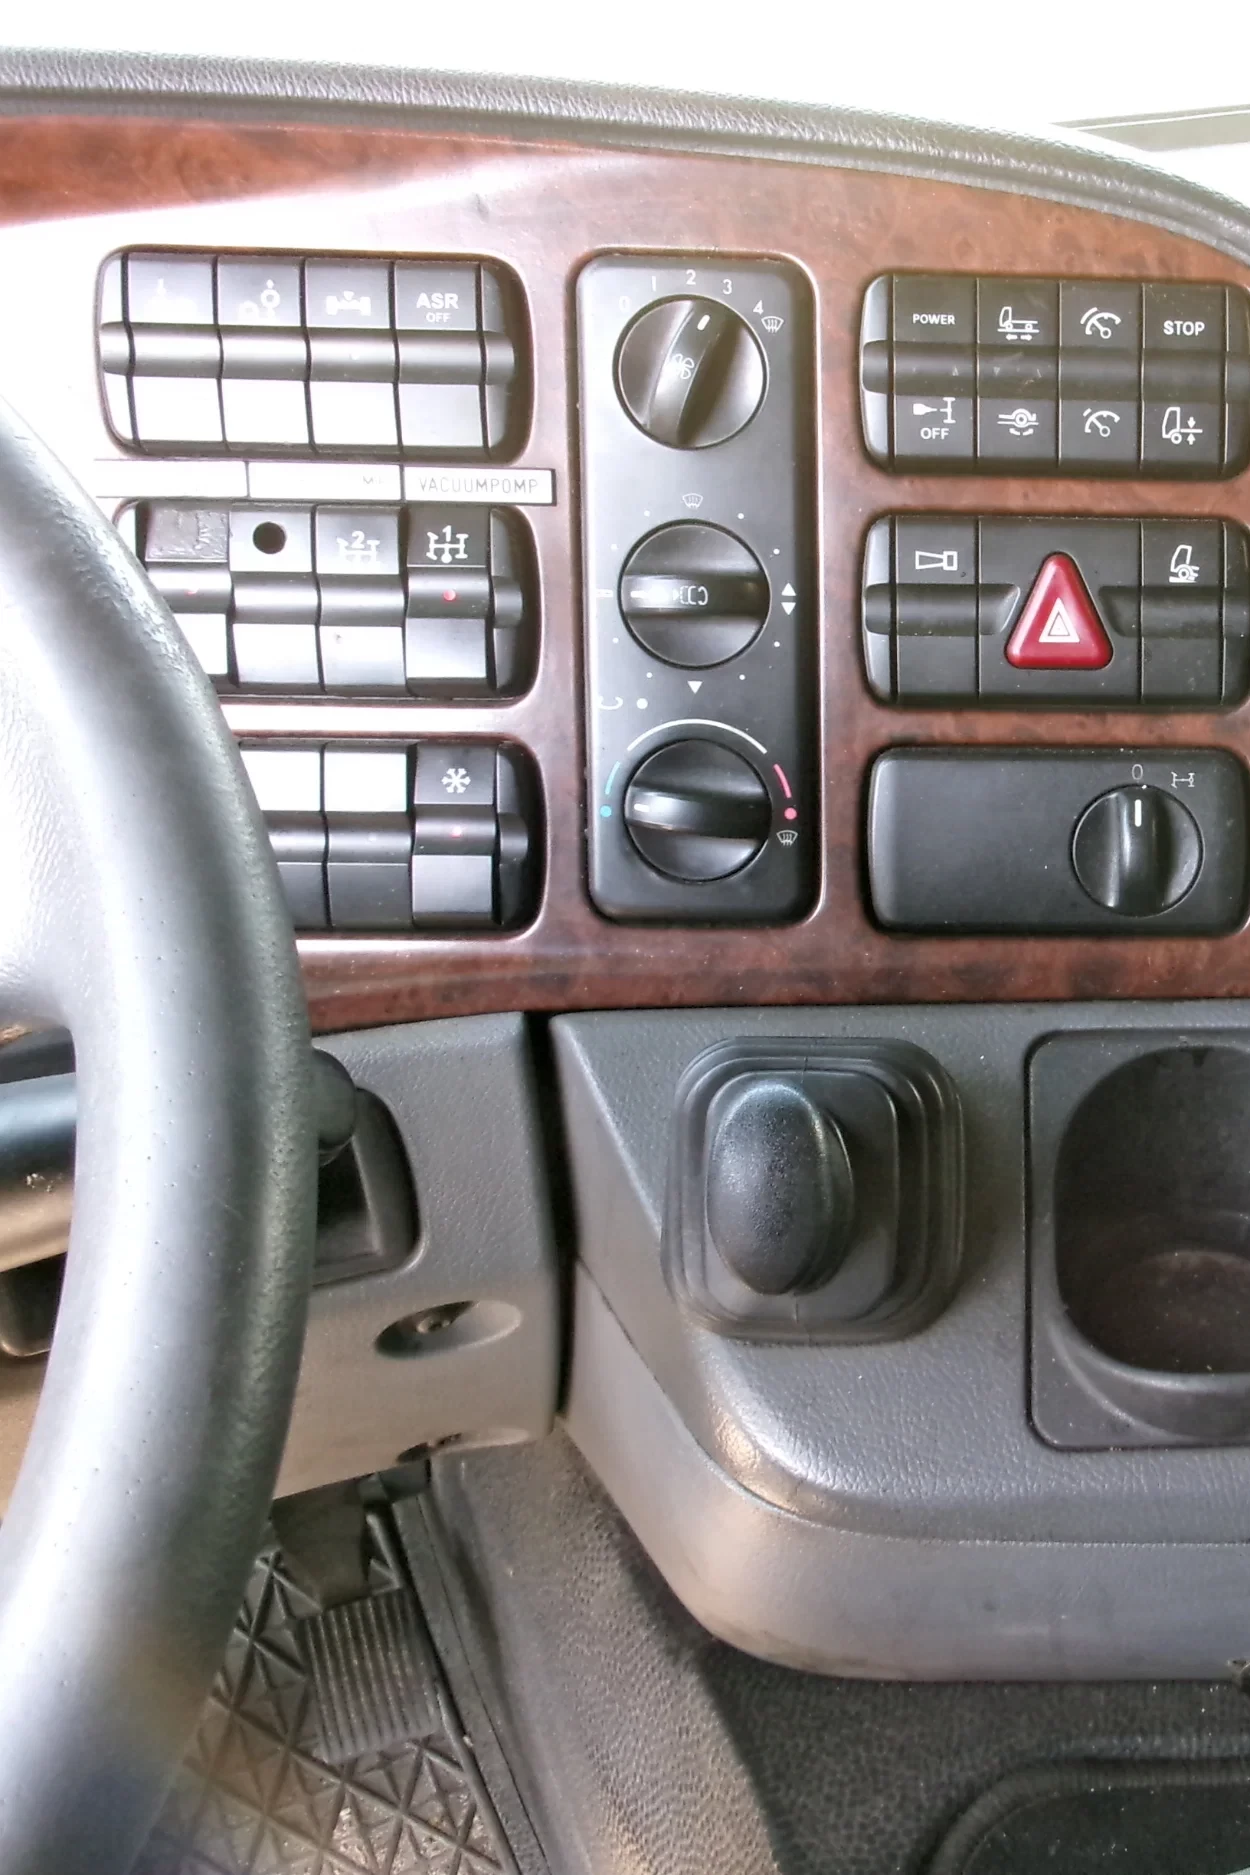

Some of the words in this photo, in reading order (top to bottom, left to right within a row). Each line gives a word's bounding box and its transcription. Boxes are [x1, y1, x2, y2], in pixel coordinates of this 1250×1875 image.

[686, 269, 697, 286] 2
[722, 279, 733, 295] 3
[416, 292, 459, 310] ASR
[752, 300, 764, 315] 4
[425, 311, 452, 323] OFF
[912, 313, 955, 325] POWER
[1163, 320, 1205, 336] STOP
[920, 427, 949, 440] OFF
[419, 475, 539, 495] VACUUMPOMP
[442, 525, 453, 542] 1
[1131, 763, 1144, 781] 0
